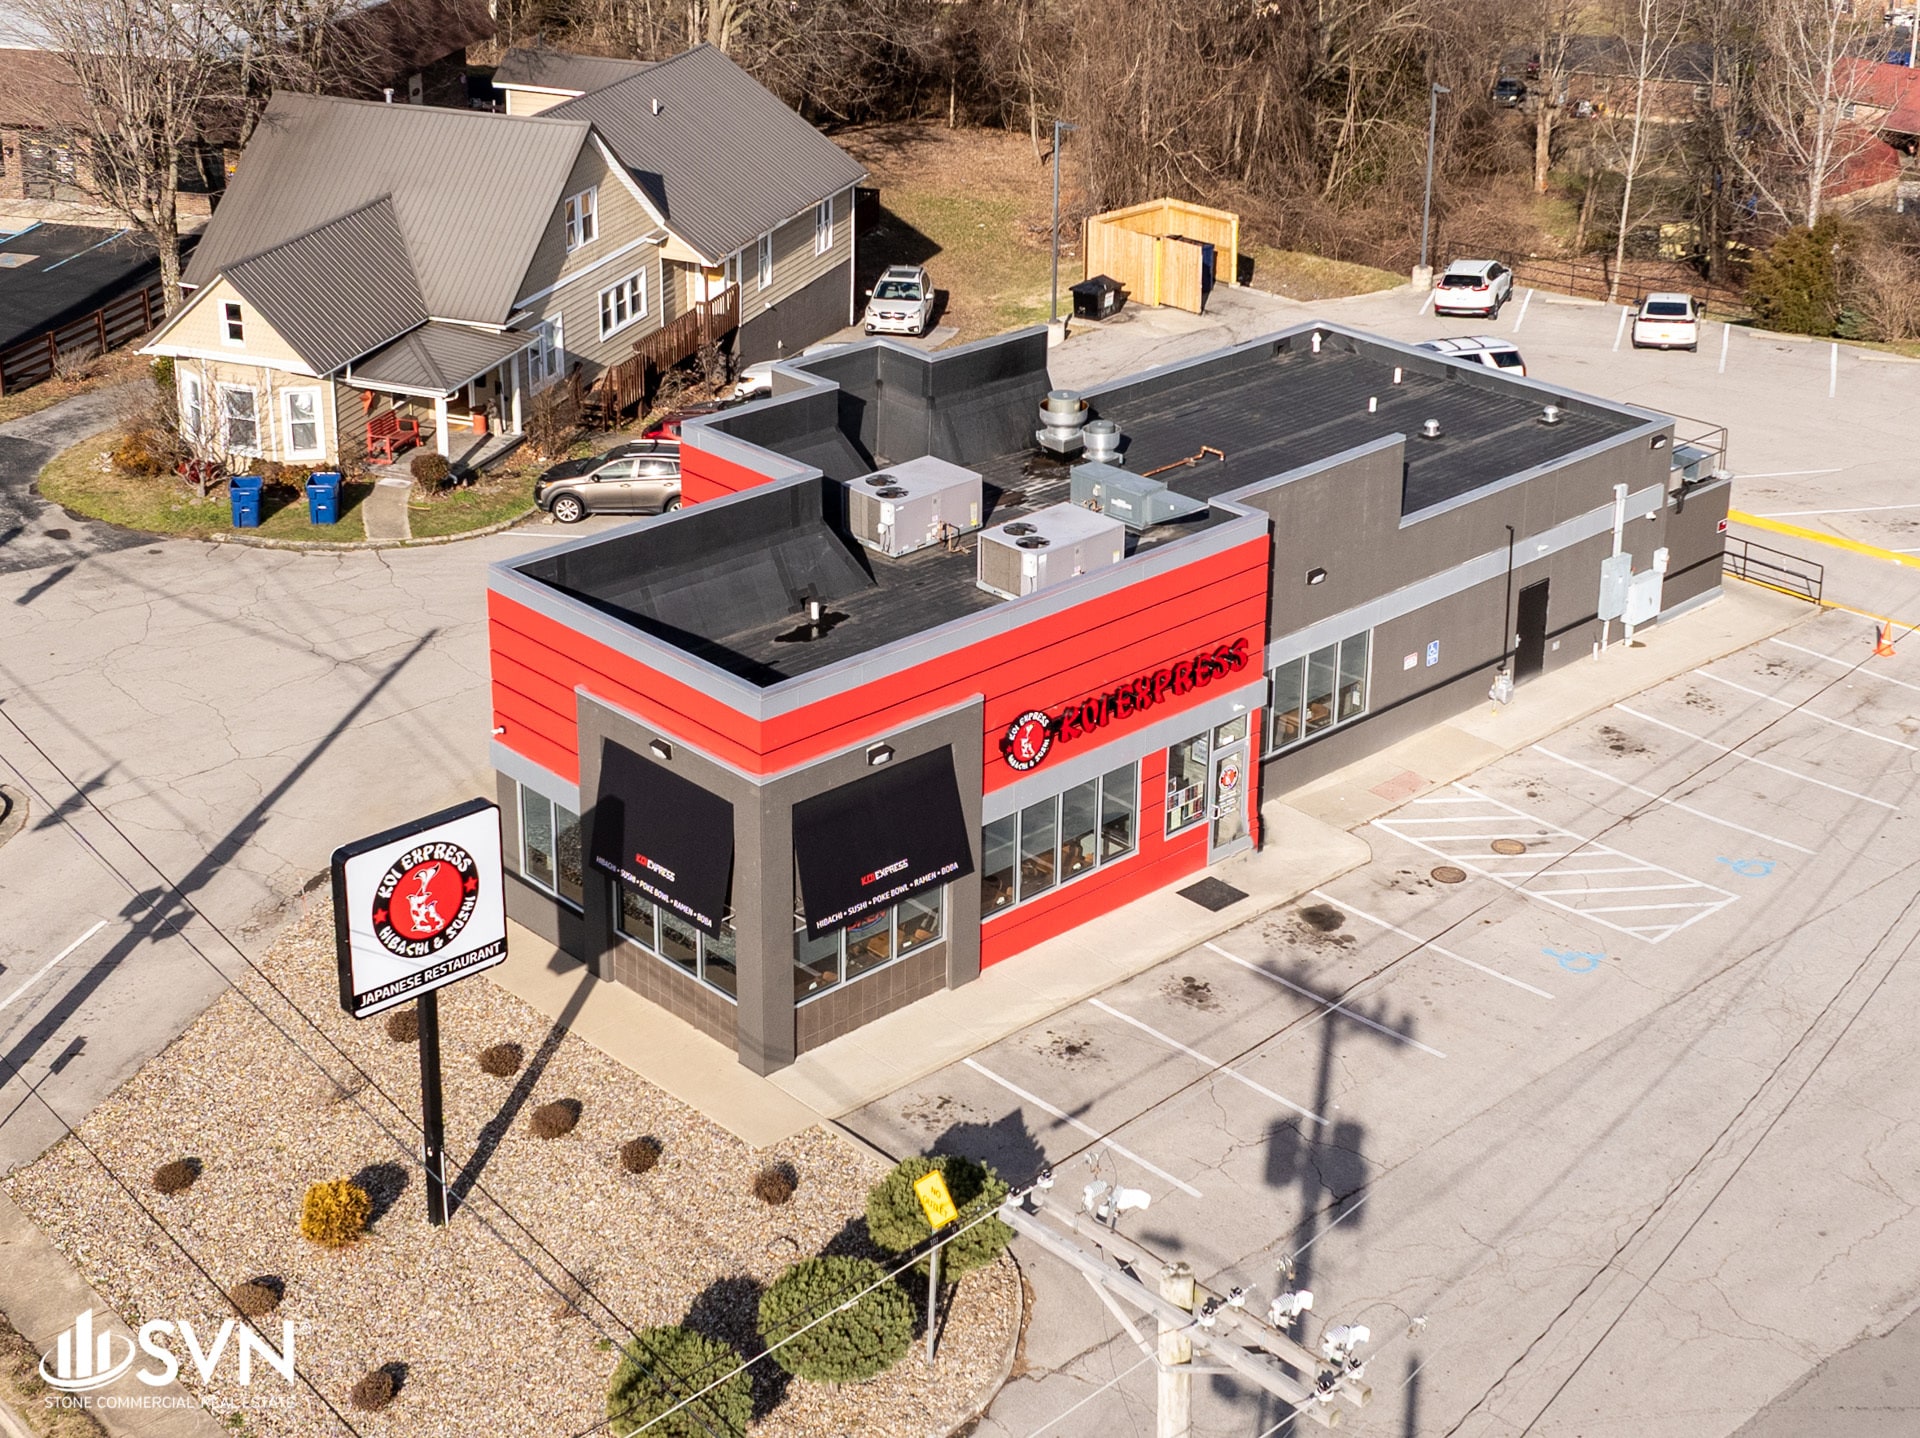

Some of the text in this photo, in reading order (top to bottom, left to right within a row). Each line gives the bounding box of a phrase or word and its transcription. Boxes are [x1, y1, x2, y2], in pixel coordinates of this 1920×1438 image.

[1058, 637, 1249, 743] KOI EXPRESS
[1009, 711, 1050, 741] KOI EXPRESS
[377, 843, 472, 899] KOI EXPRESS
[378, 895, 476, 956] HIBACHI & SUSHI
[815, 911, 844, 930] HIBACHI
[847, 900, 869, 916] SUSHI
[872, 891, 891, 905] POKE
[890, 883, 910, 898] BOWL
[913, 871, 937, 888] RAMEN
[360, 941, 501, 1008] JAPANESE RESTAURANT
[922, 1194, 948, 1218] OUTLET
[930, 1185, 942, 1199] NO
